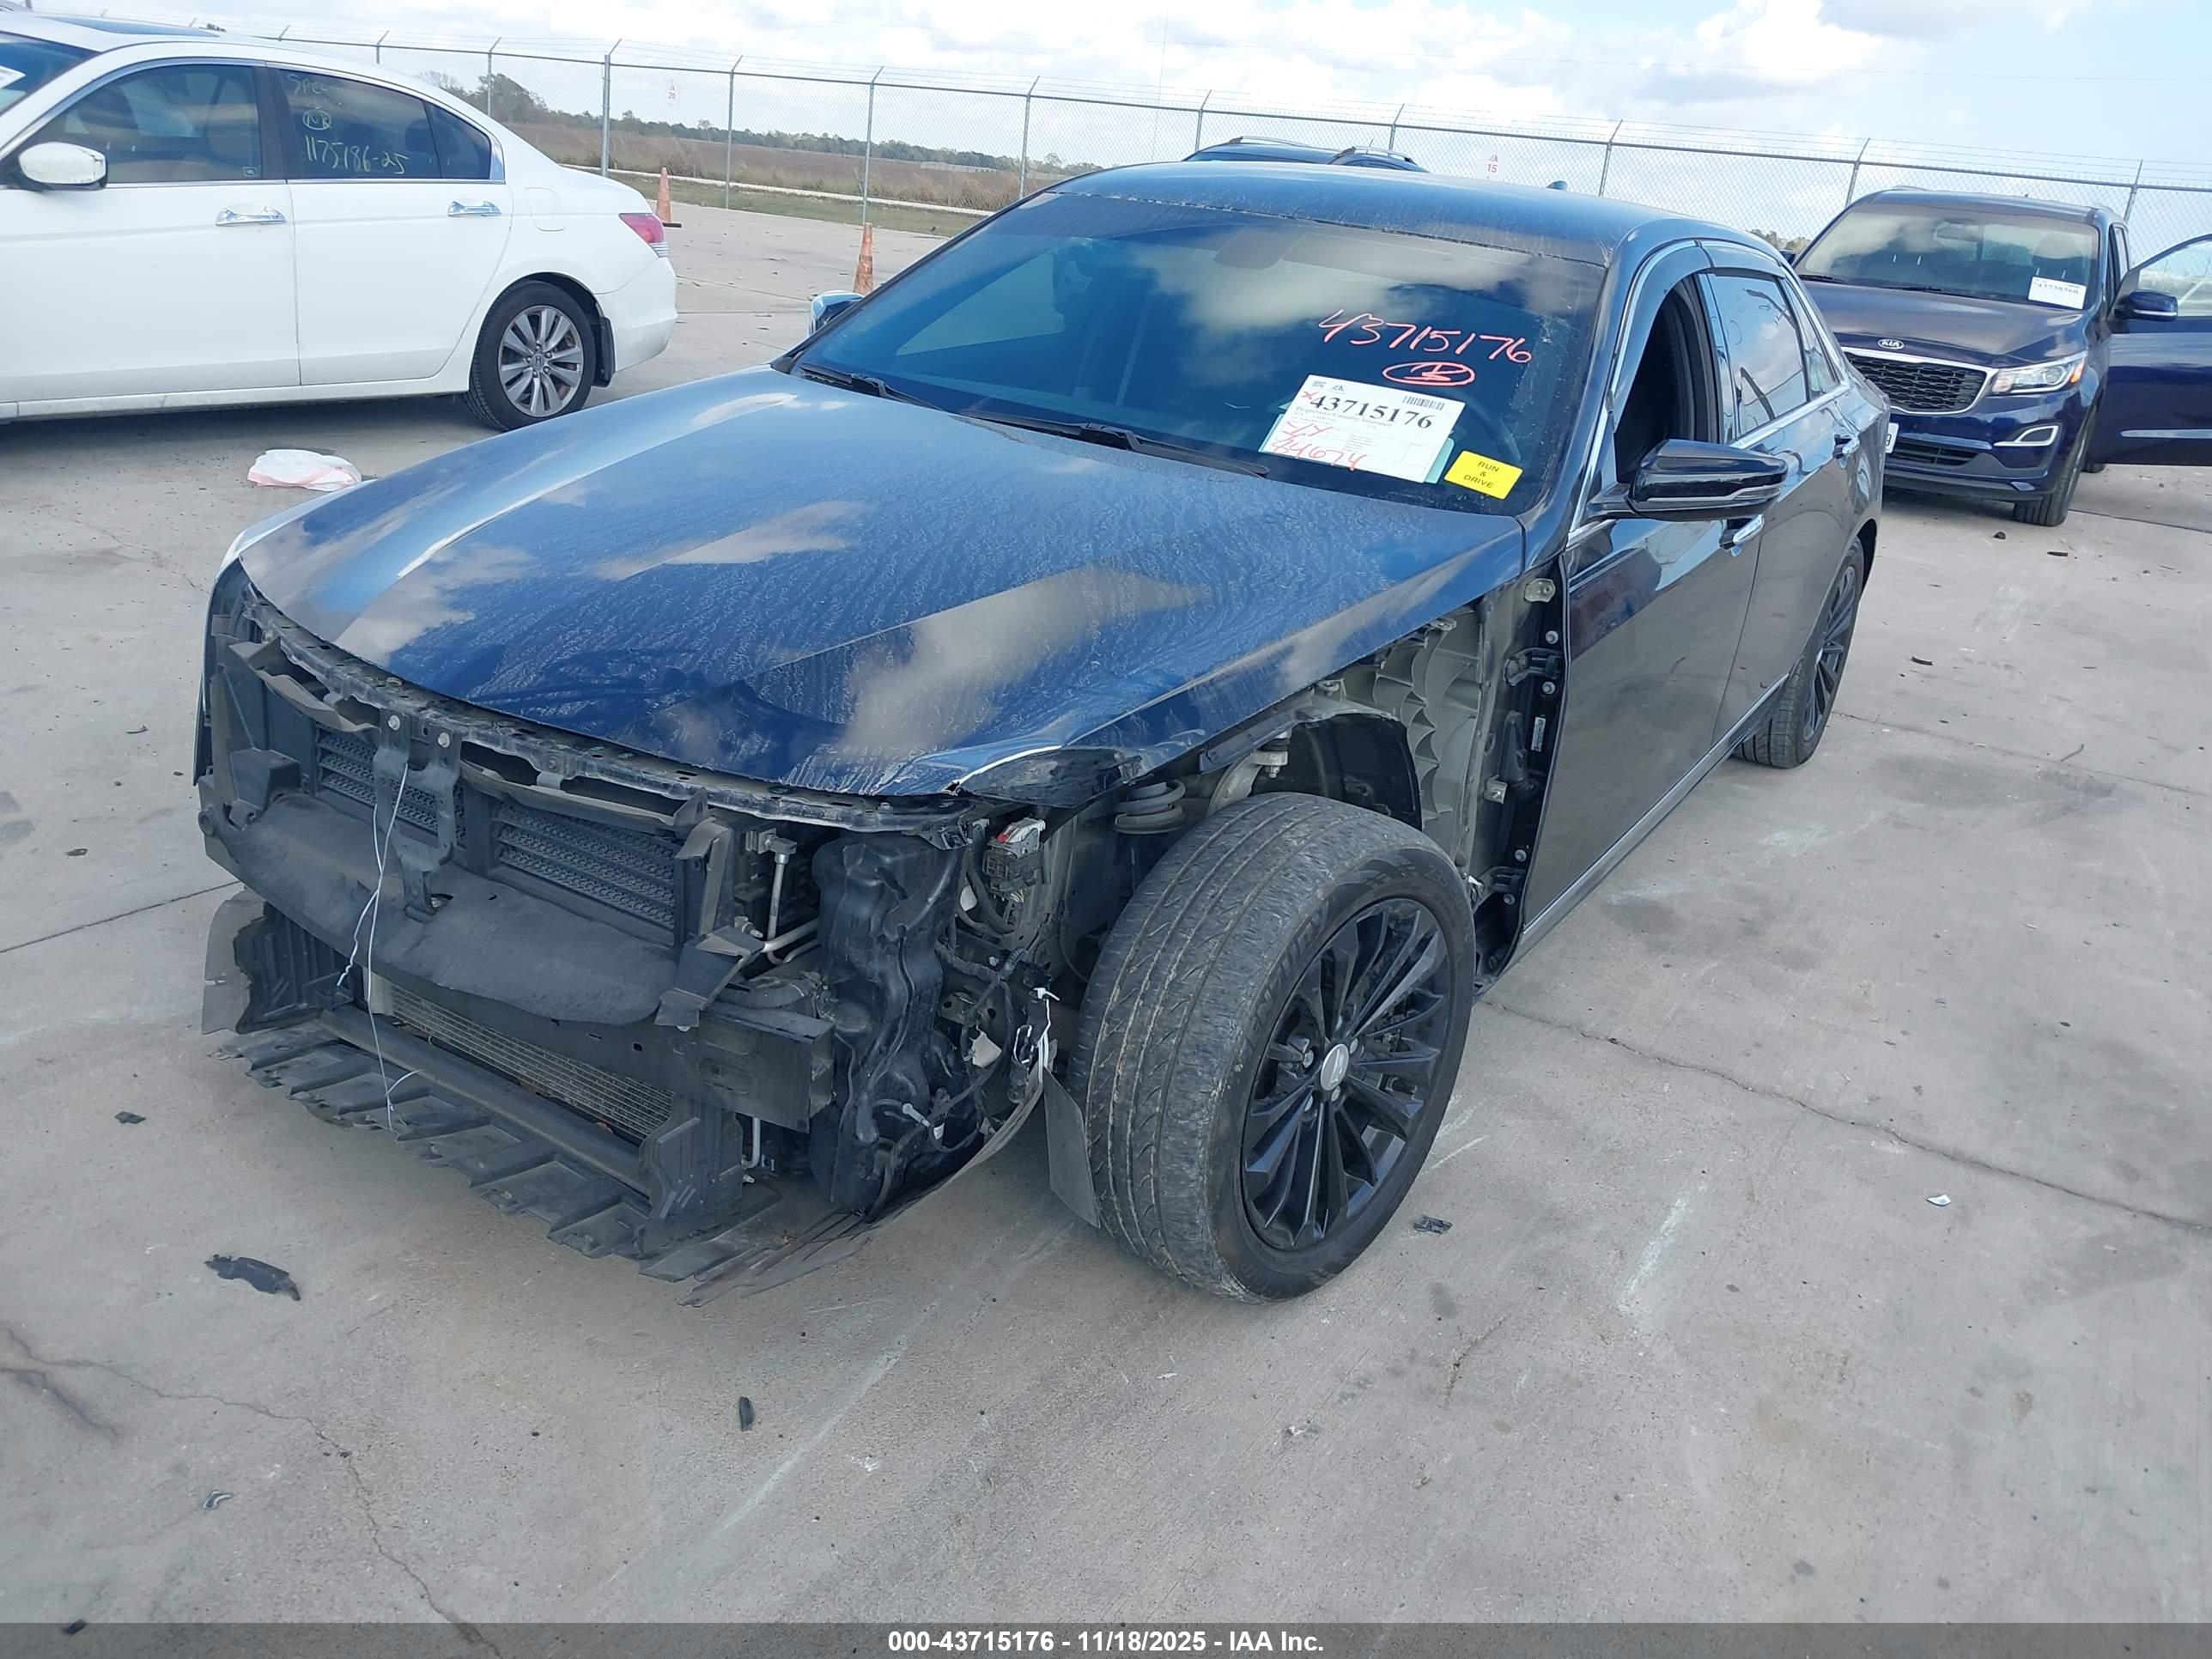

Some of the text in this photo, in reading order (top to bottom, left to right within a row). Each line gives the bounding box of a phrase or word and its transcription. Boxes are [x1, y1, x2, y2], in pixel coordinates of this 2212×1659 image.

[1487, 164, 1498, 173] 15
[1318, 309, 1532, 363] 43715176
[1310, 395, 1437, 429] 43715176
[1478, 461, 1499, 472] RUN
[1463, 474, 1494, 489] DRIVE
